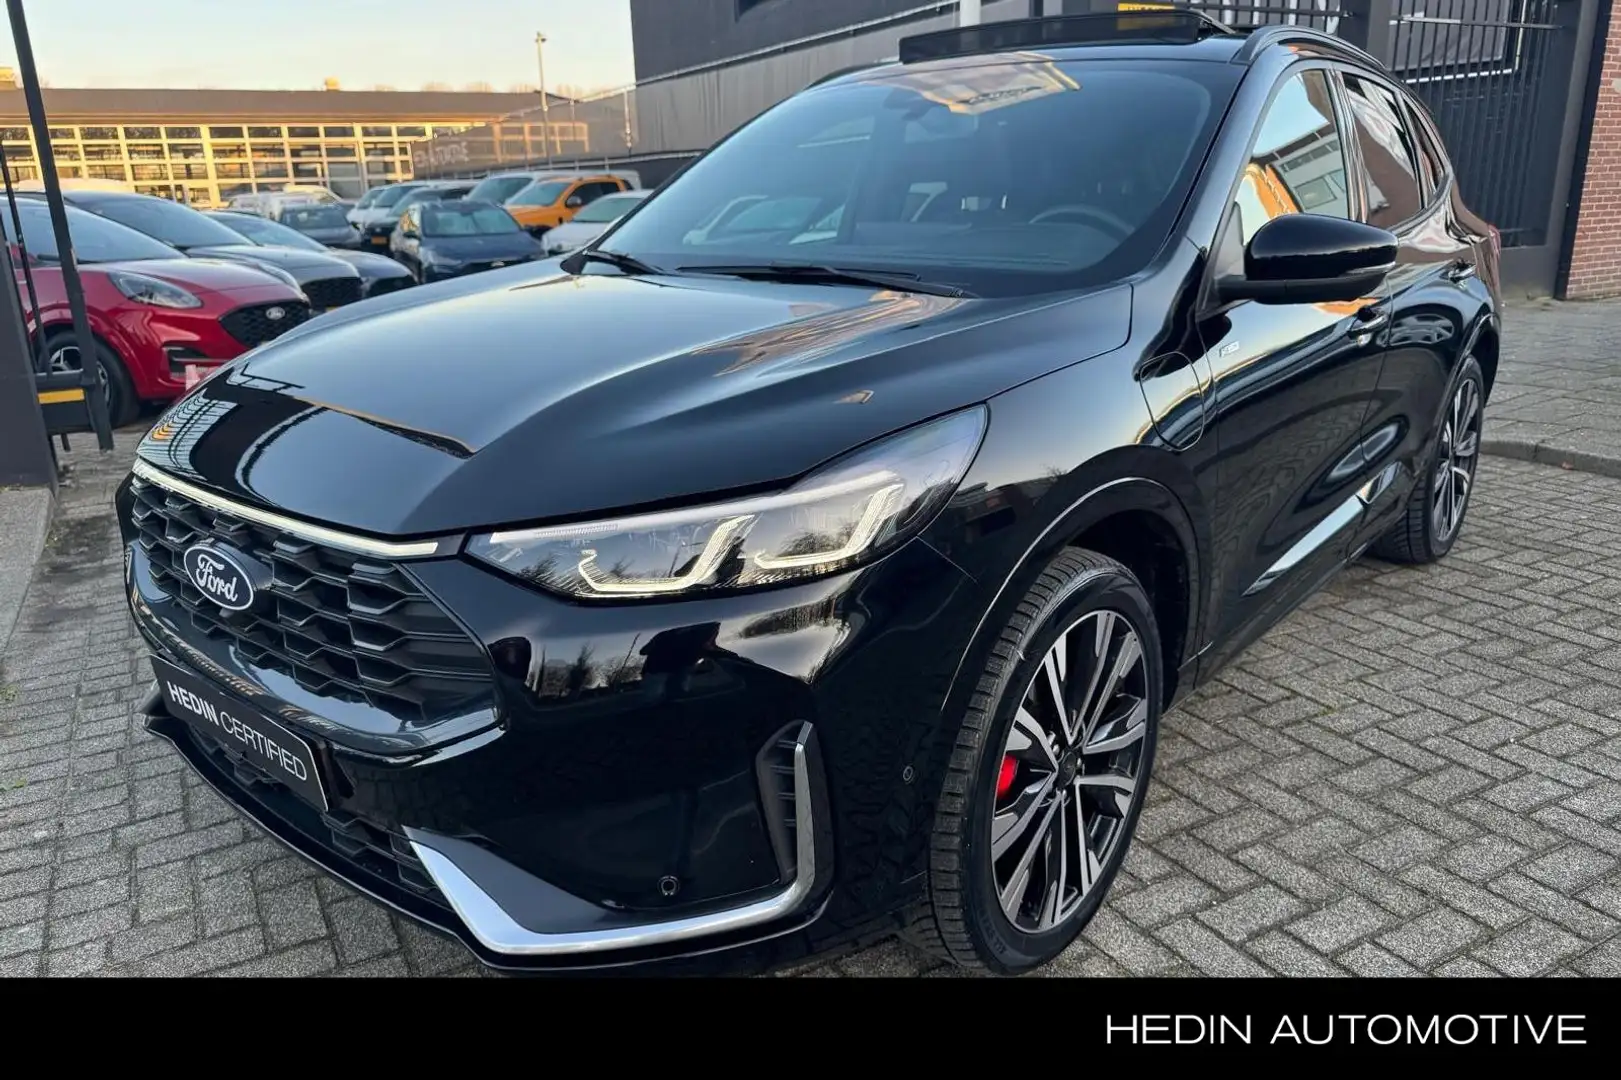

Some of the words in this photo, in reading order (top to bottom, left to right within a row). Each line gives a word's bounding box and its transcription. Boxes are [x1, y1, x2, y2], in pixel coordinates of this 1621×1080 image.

[196, 553, 238, 602] Ford
[166, 680, 220, 726] HEDIN
[219, 710, 308, 782] CERTIFIED
